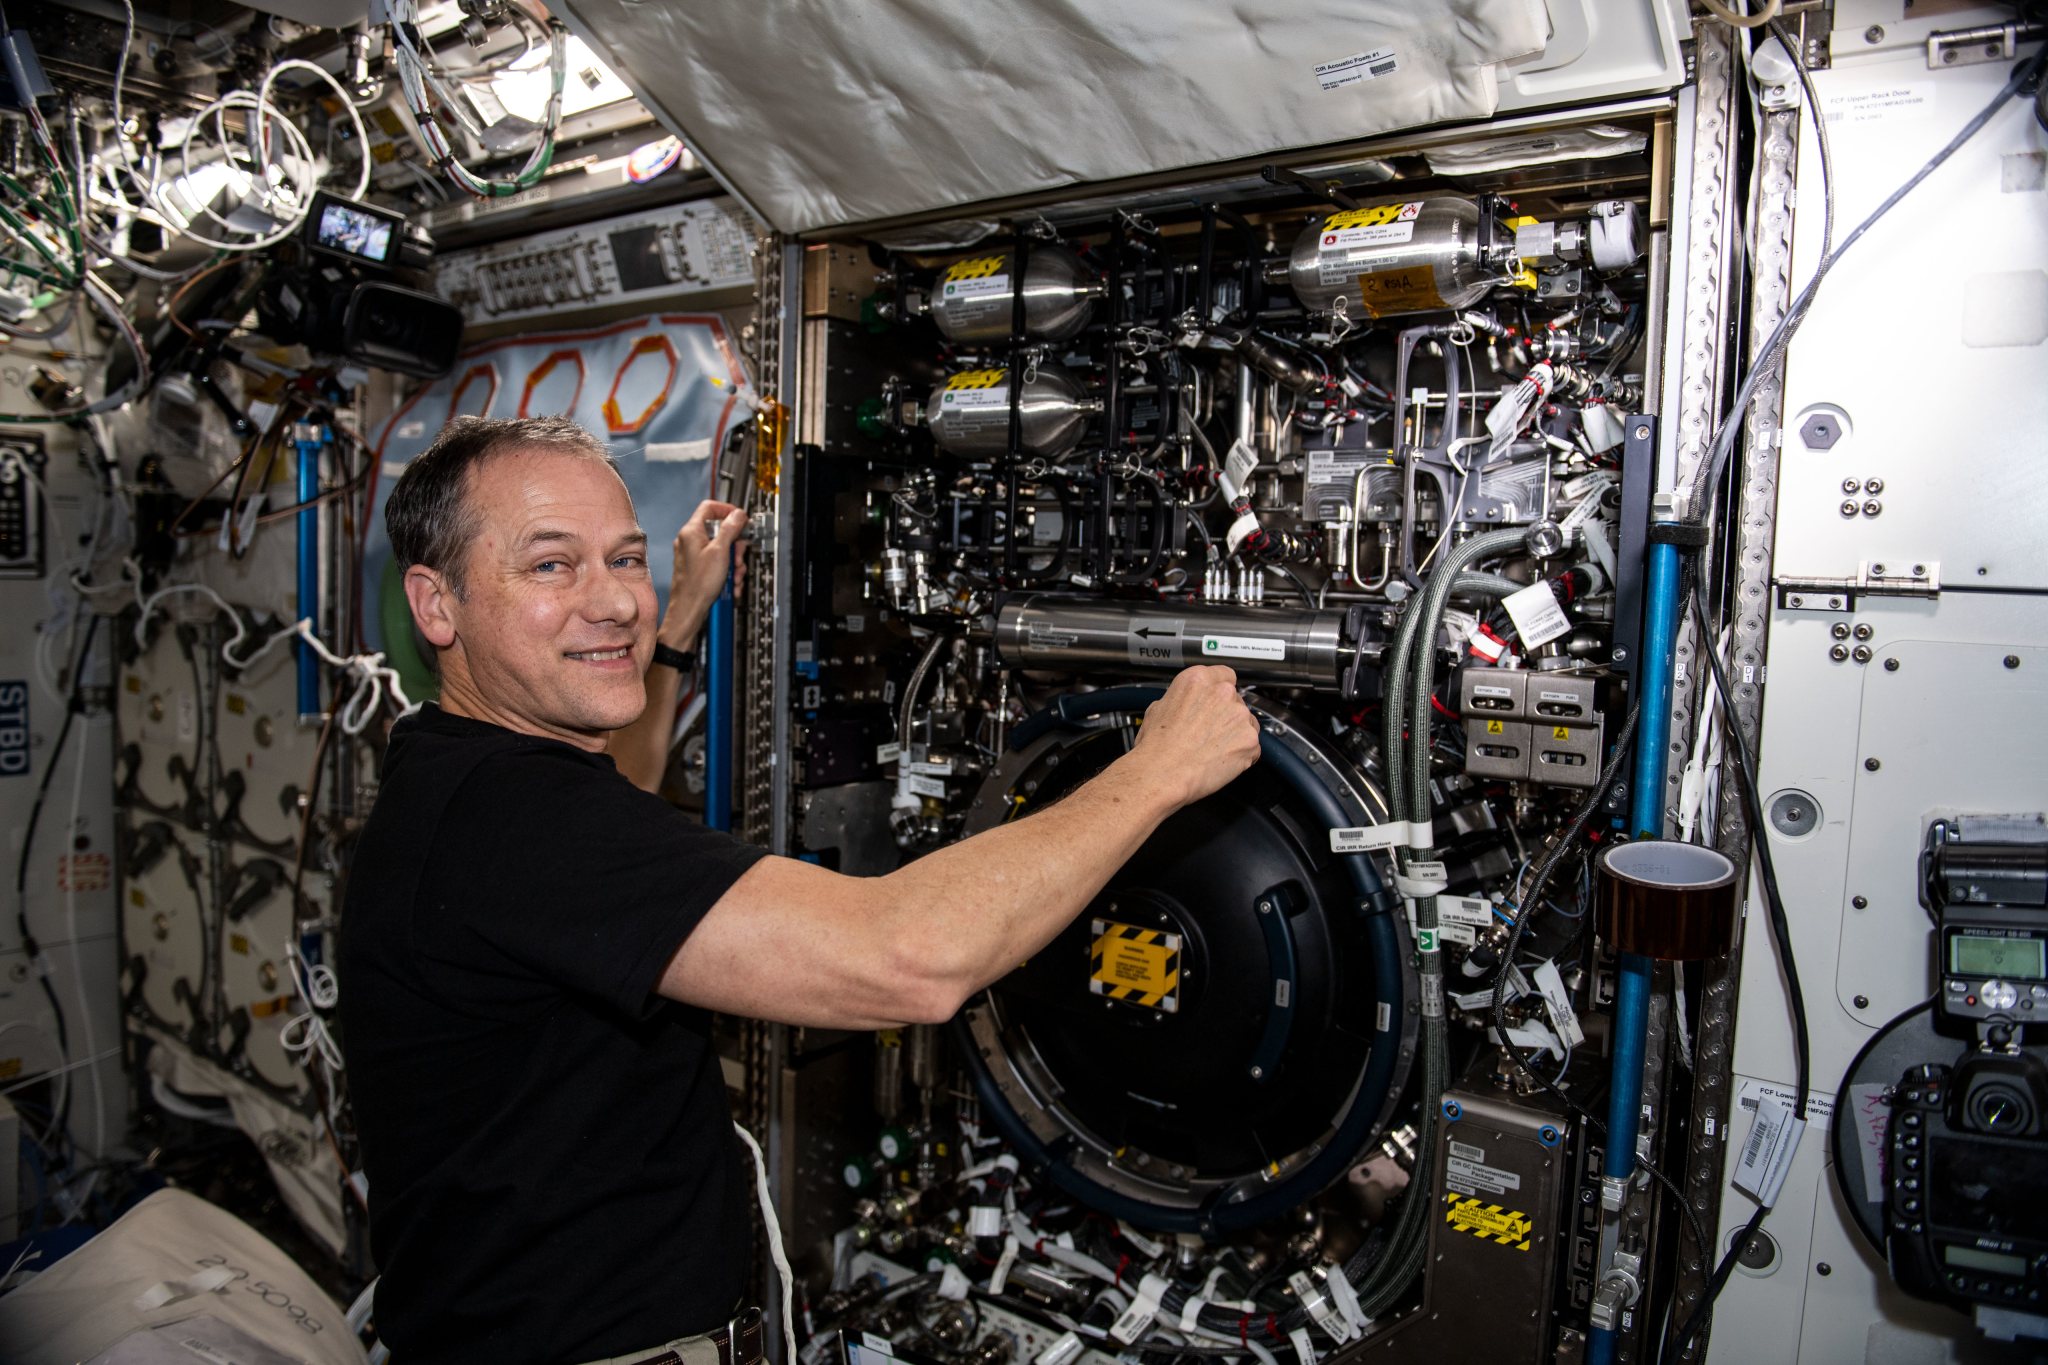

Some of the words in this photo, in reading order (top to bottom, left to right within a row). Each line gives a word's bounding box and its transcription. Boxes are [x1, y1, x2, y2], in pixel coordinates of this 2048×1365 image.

[1328, 60, 1353, 69] Acoustic
[1354, 55, 1371, 63] Foam
[1139, 648, 1171, 659] FLOW
[0, 686, 25, 772] STBD
[1461, 916, 1476, 924] Supply
[1963, 928, 2005, 936] SPEEDLIGHT
[1776, 1091, 1798, 1100] Lower
[1472, 1164, 1515, 1181] Instrumentation
[1472, 1171, 1495, 1181] Package
[1464, 1205, 1496, 1218] CAUTION
[1976, 1238, 1999, 1249] Nikon
